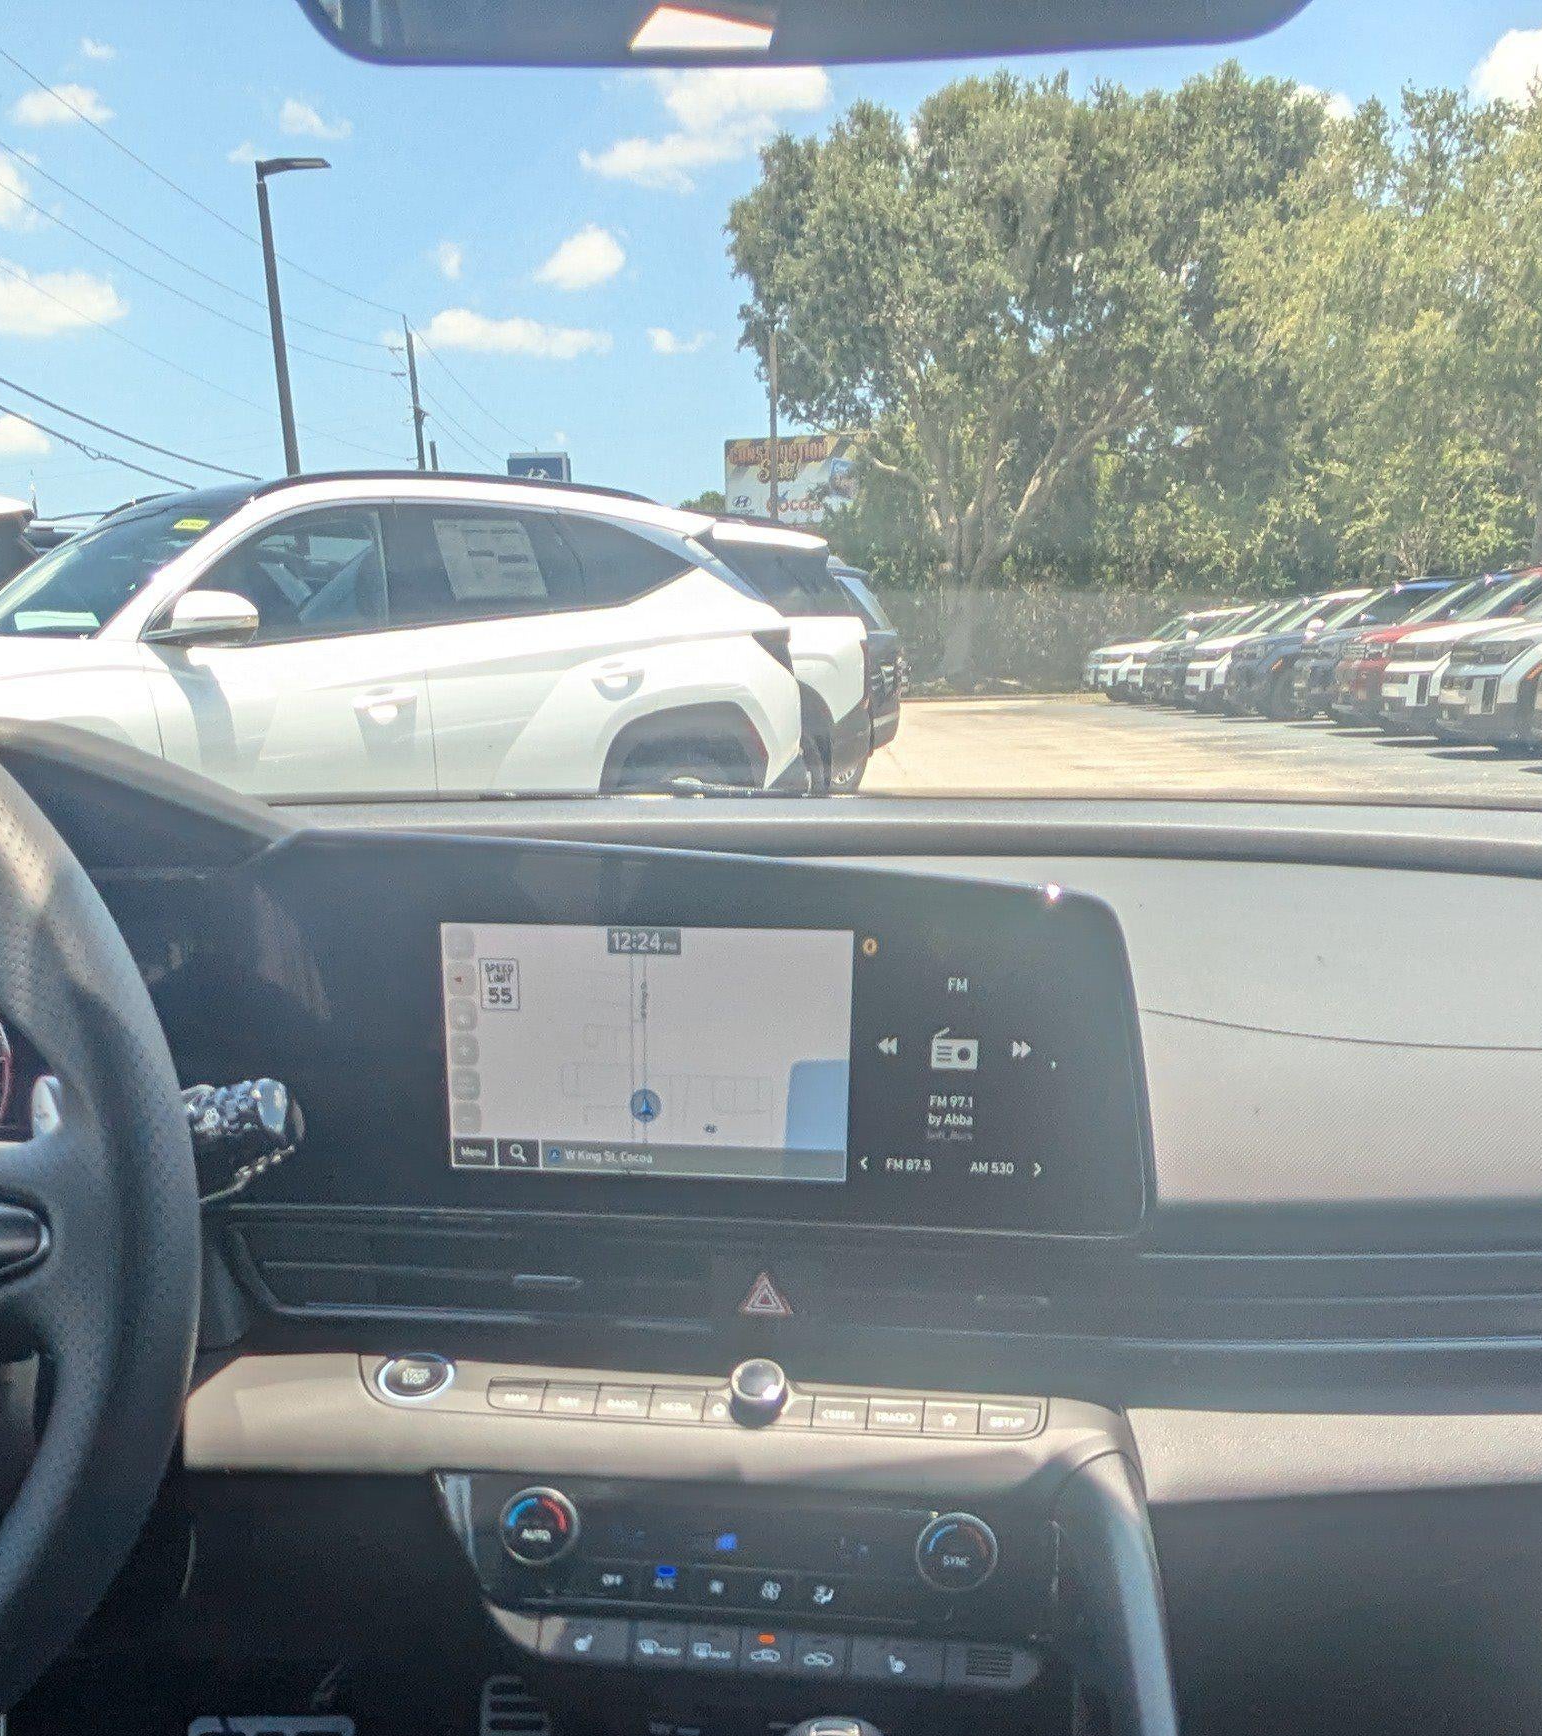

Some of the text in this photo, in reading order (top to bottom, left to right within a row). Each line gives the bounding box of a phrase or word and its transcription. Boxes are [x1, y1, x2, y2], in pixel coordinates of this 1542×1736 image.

[611, 931, 659, 951] 12:24
[947, 977, 968, 993] FM
[488, 986, 513, 1004] 55
[929, 1094, 947, 1108] FM
[928, 1112, 973, 1127] by Abba
[885, 1157, 903, 1171] FM
[969, 1160, 1014, 1175] AM 530
[606, 1398, 638, 1409] RADIO
[989, 1416, 1025, 1428] SETUP
